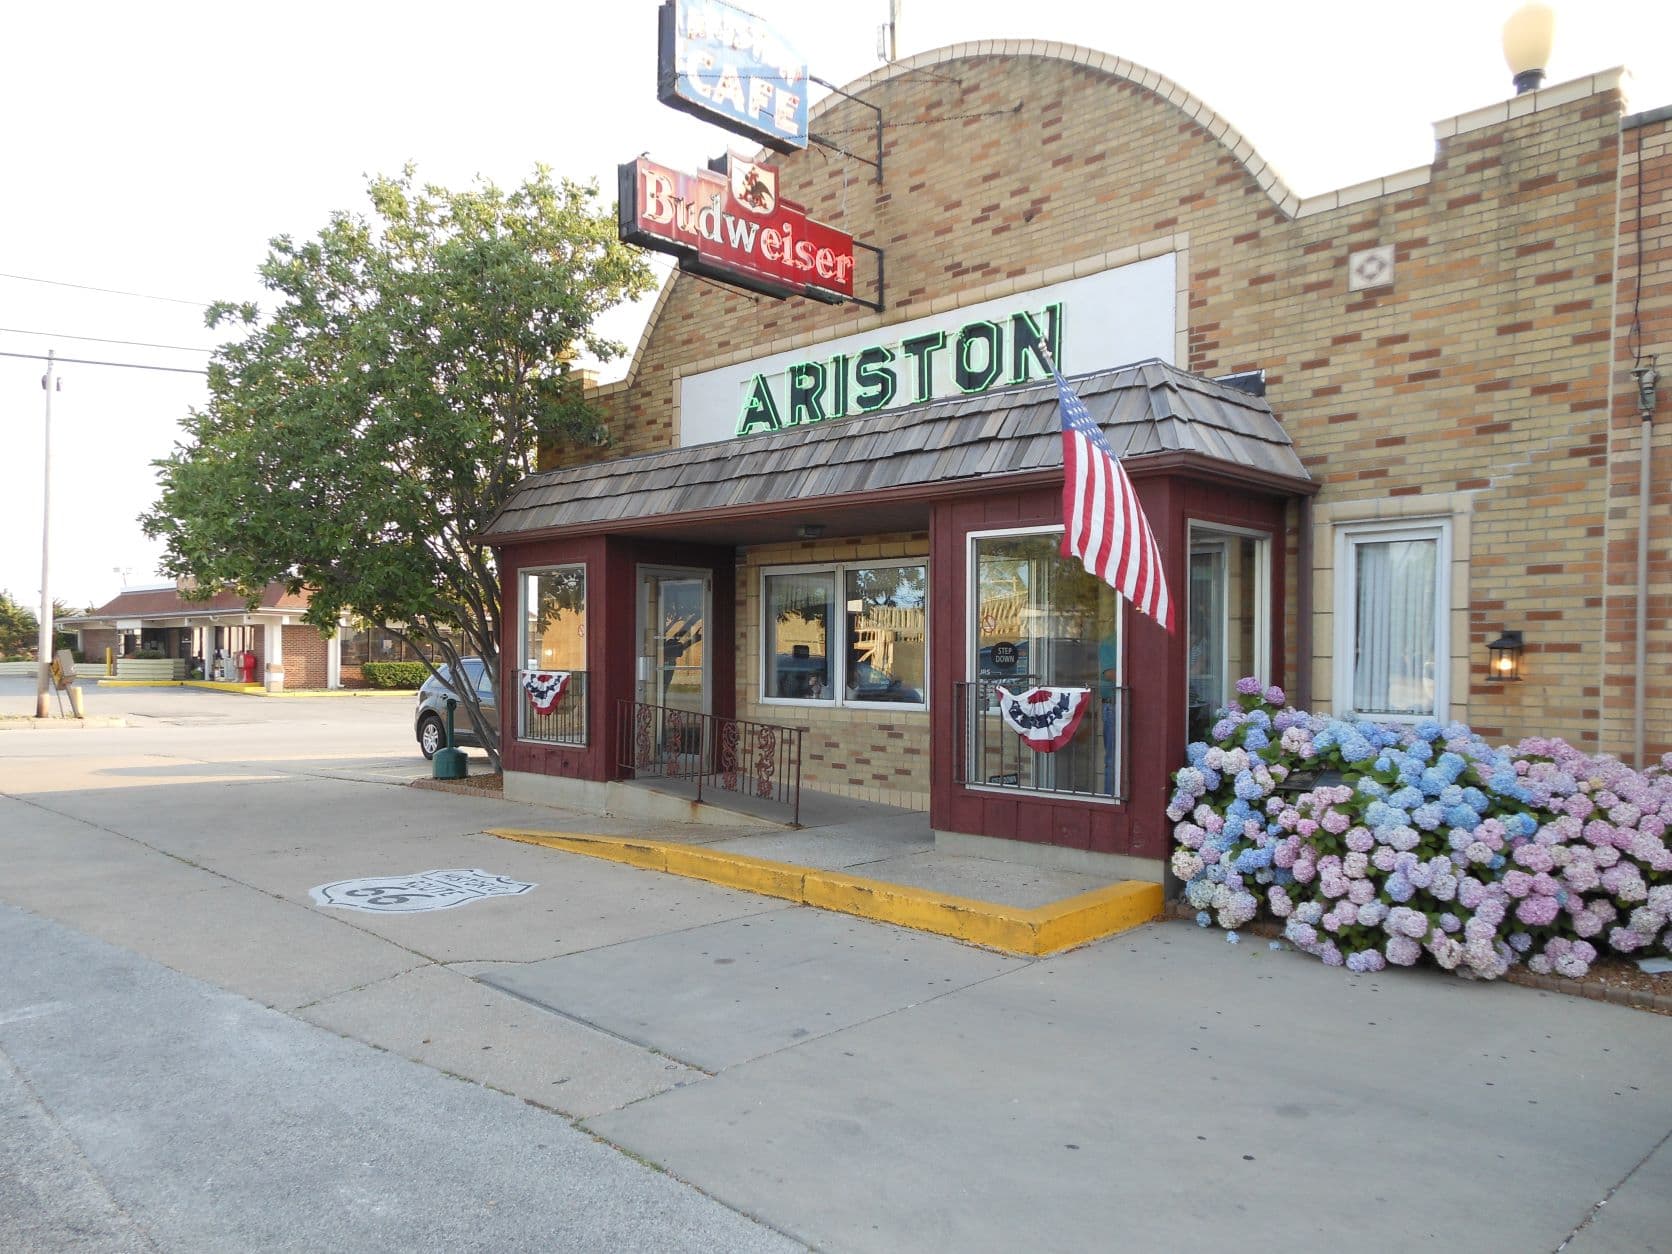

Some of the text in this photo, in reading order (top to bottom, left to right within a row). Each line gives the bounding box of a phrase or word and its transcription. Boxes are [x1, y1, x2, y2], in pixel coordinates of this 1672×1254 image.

[687, 51, 800, 135] CAFE
[640, 167, 855, 284] Budweiser
[735, 302, 1064, 437] ARISTON
[345, 886, 434, 905] 66
[399, 880, 465, 896] ROUTE
